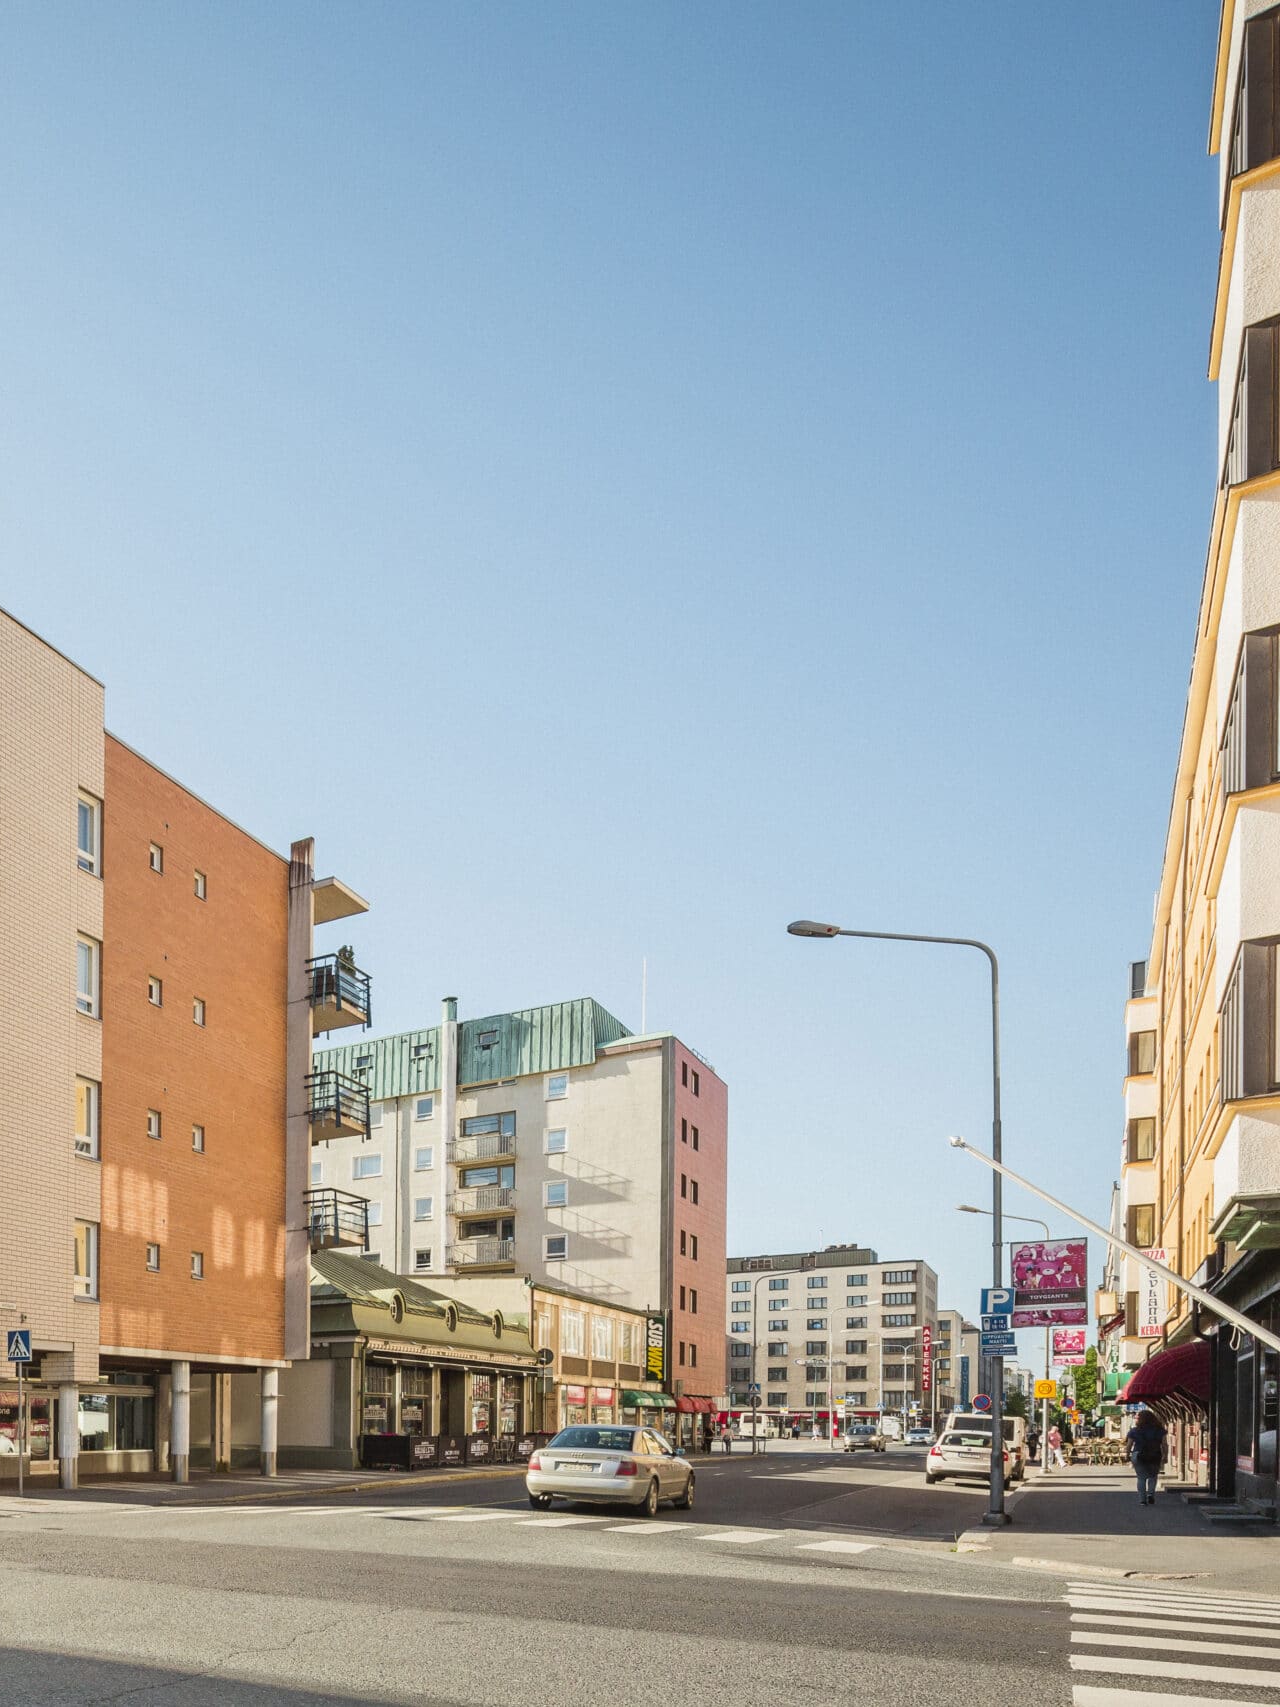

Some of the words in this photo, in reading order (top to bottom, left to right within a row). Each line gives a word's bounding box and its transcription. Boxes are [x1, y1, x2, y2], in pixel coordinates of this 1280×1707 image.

[986, 1290, 1010, 1313] P
[1147, 1266, 1158, 1324] EVLANA
[648, 1319, 663, 1379] SUBWAY
